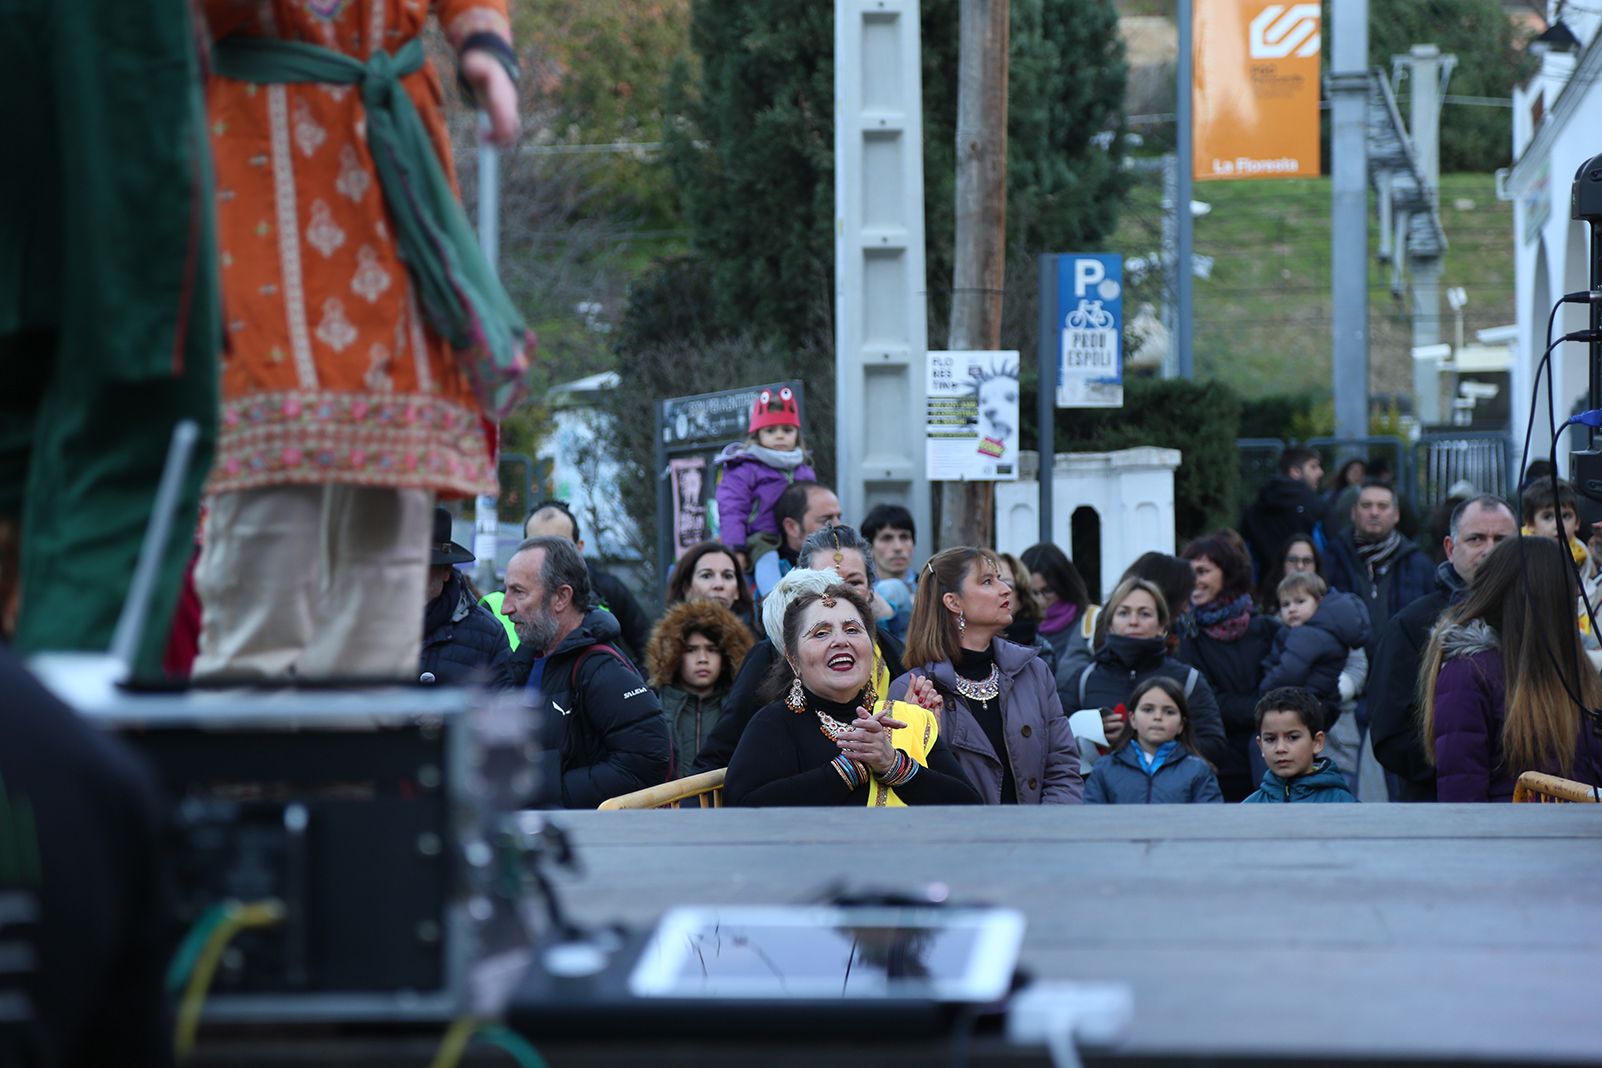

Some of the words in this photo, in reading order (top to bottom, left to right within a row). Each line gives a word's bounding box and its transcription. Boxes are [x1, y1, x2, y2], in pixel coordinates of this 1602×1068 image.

[1213, 159, 1233, 174] La
[1237, 158, 1298, 174] Floresta
[1075, 258, 1105, 298] P
